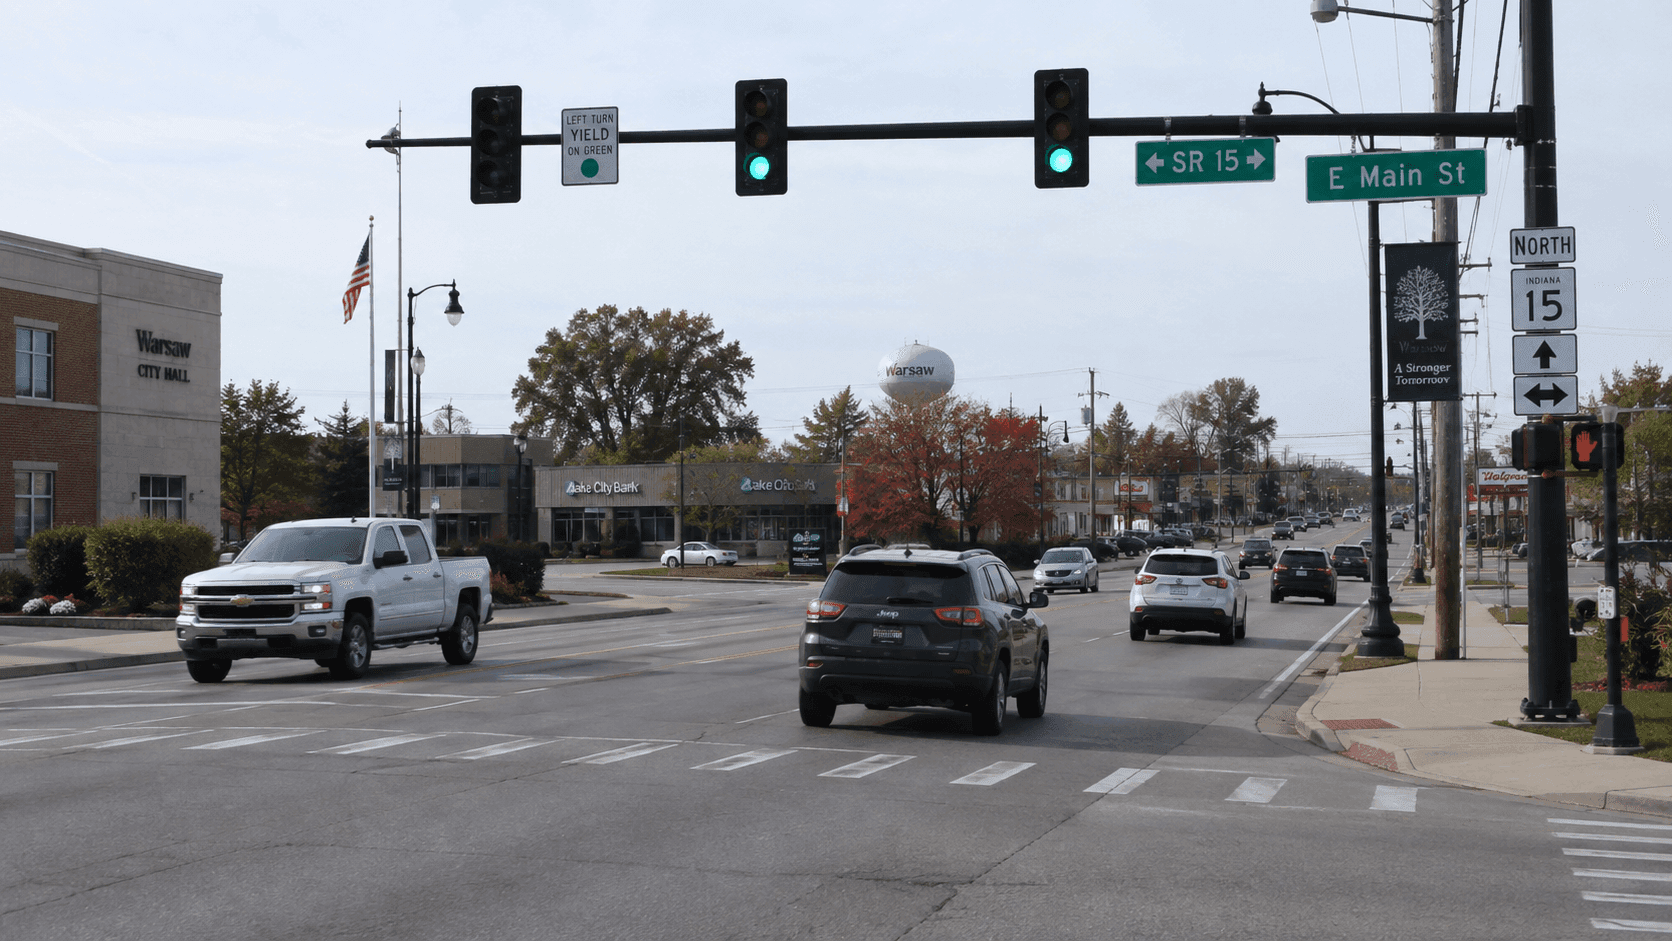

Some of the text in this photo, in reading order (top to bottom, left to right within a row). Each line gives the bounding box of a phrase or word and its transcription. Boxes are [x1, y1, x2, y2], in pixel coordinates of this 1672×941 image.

[566, 113, 614, 125] LEFT TURN
[571, 127, 609, 142] YIELD
[568, 145, 613, 156] ON GREEN
[1172, 149, 1239, 173] SR 15
[1329, 161, 1465, 190] E Main St
[1515, 236, 1571, 256] NORTH
[1525, 276, 1561, 285] INDIANA
[1526, 289, 1563, 322] 15
[135, 328, 191, 359] Warsaw
[137, 363, 190, 383] CITY HALL
[885, 362, 935, 377] Warsaw
[1394, 362, 1452, 375] A Stronger
